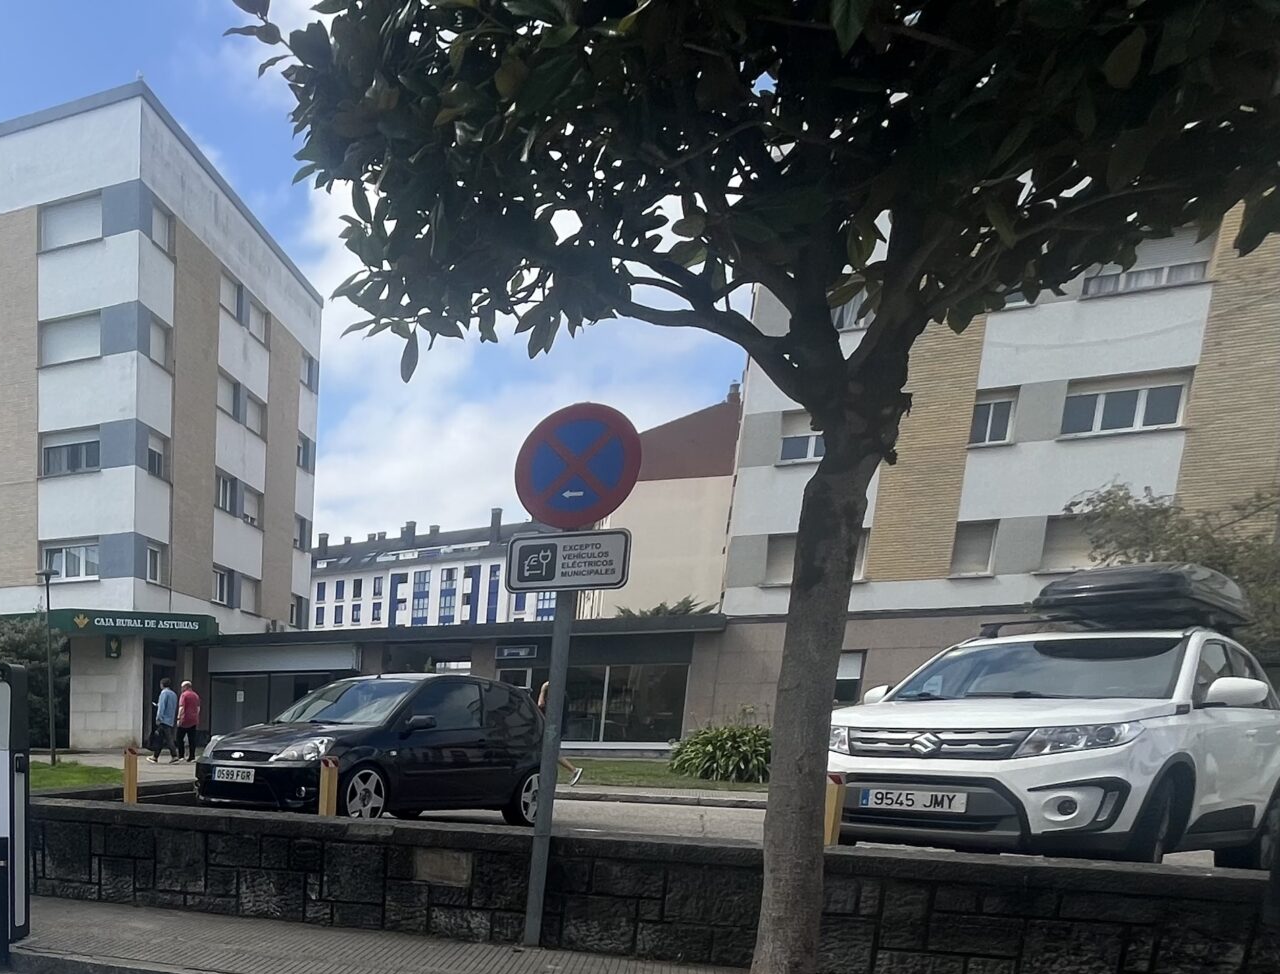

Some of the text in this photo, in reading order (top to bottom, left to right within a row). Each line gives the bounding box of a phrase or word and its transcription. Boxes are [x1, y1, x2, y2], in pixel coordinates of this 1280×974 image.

[563, 543, 601, 551] EXCEPTO
[562, 551, 609, 560] VEHÍCULOS
[561, 559, 613, 569] ELÉCTRICOS
[561, 568, 616, 577] MUNICIPALES
[94, 617, 199, 630] CAJA RURAL DE ASTURIAS
[216, 769, 252, 781] 0599 FGR
[873, 791, 957, 809] 9545 JMY
